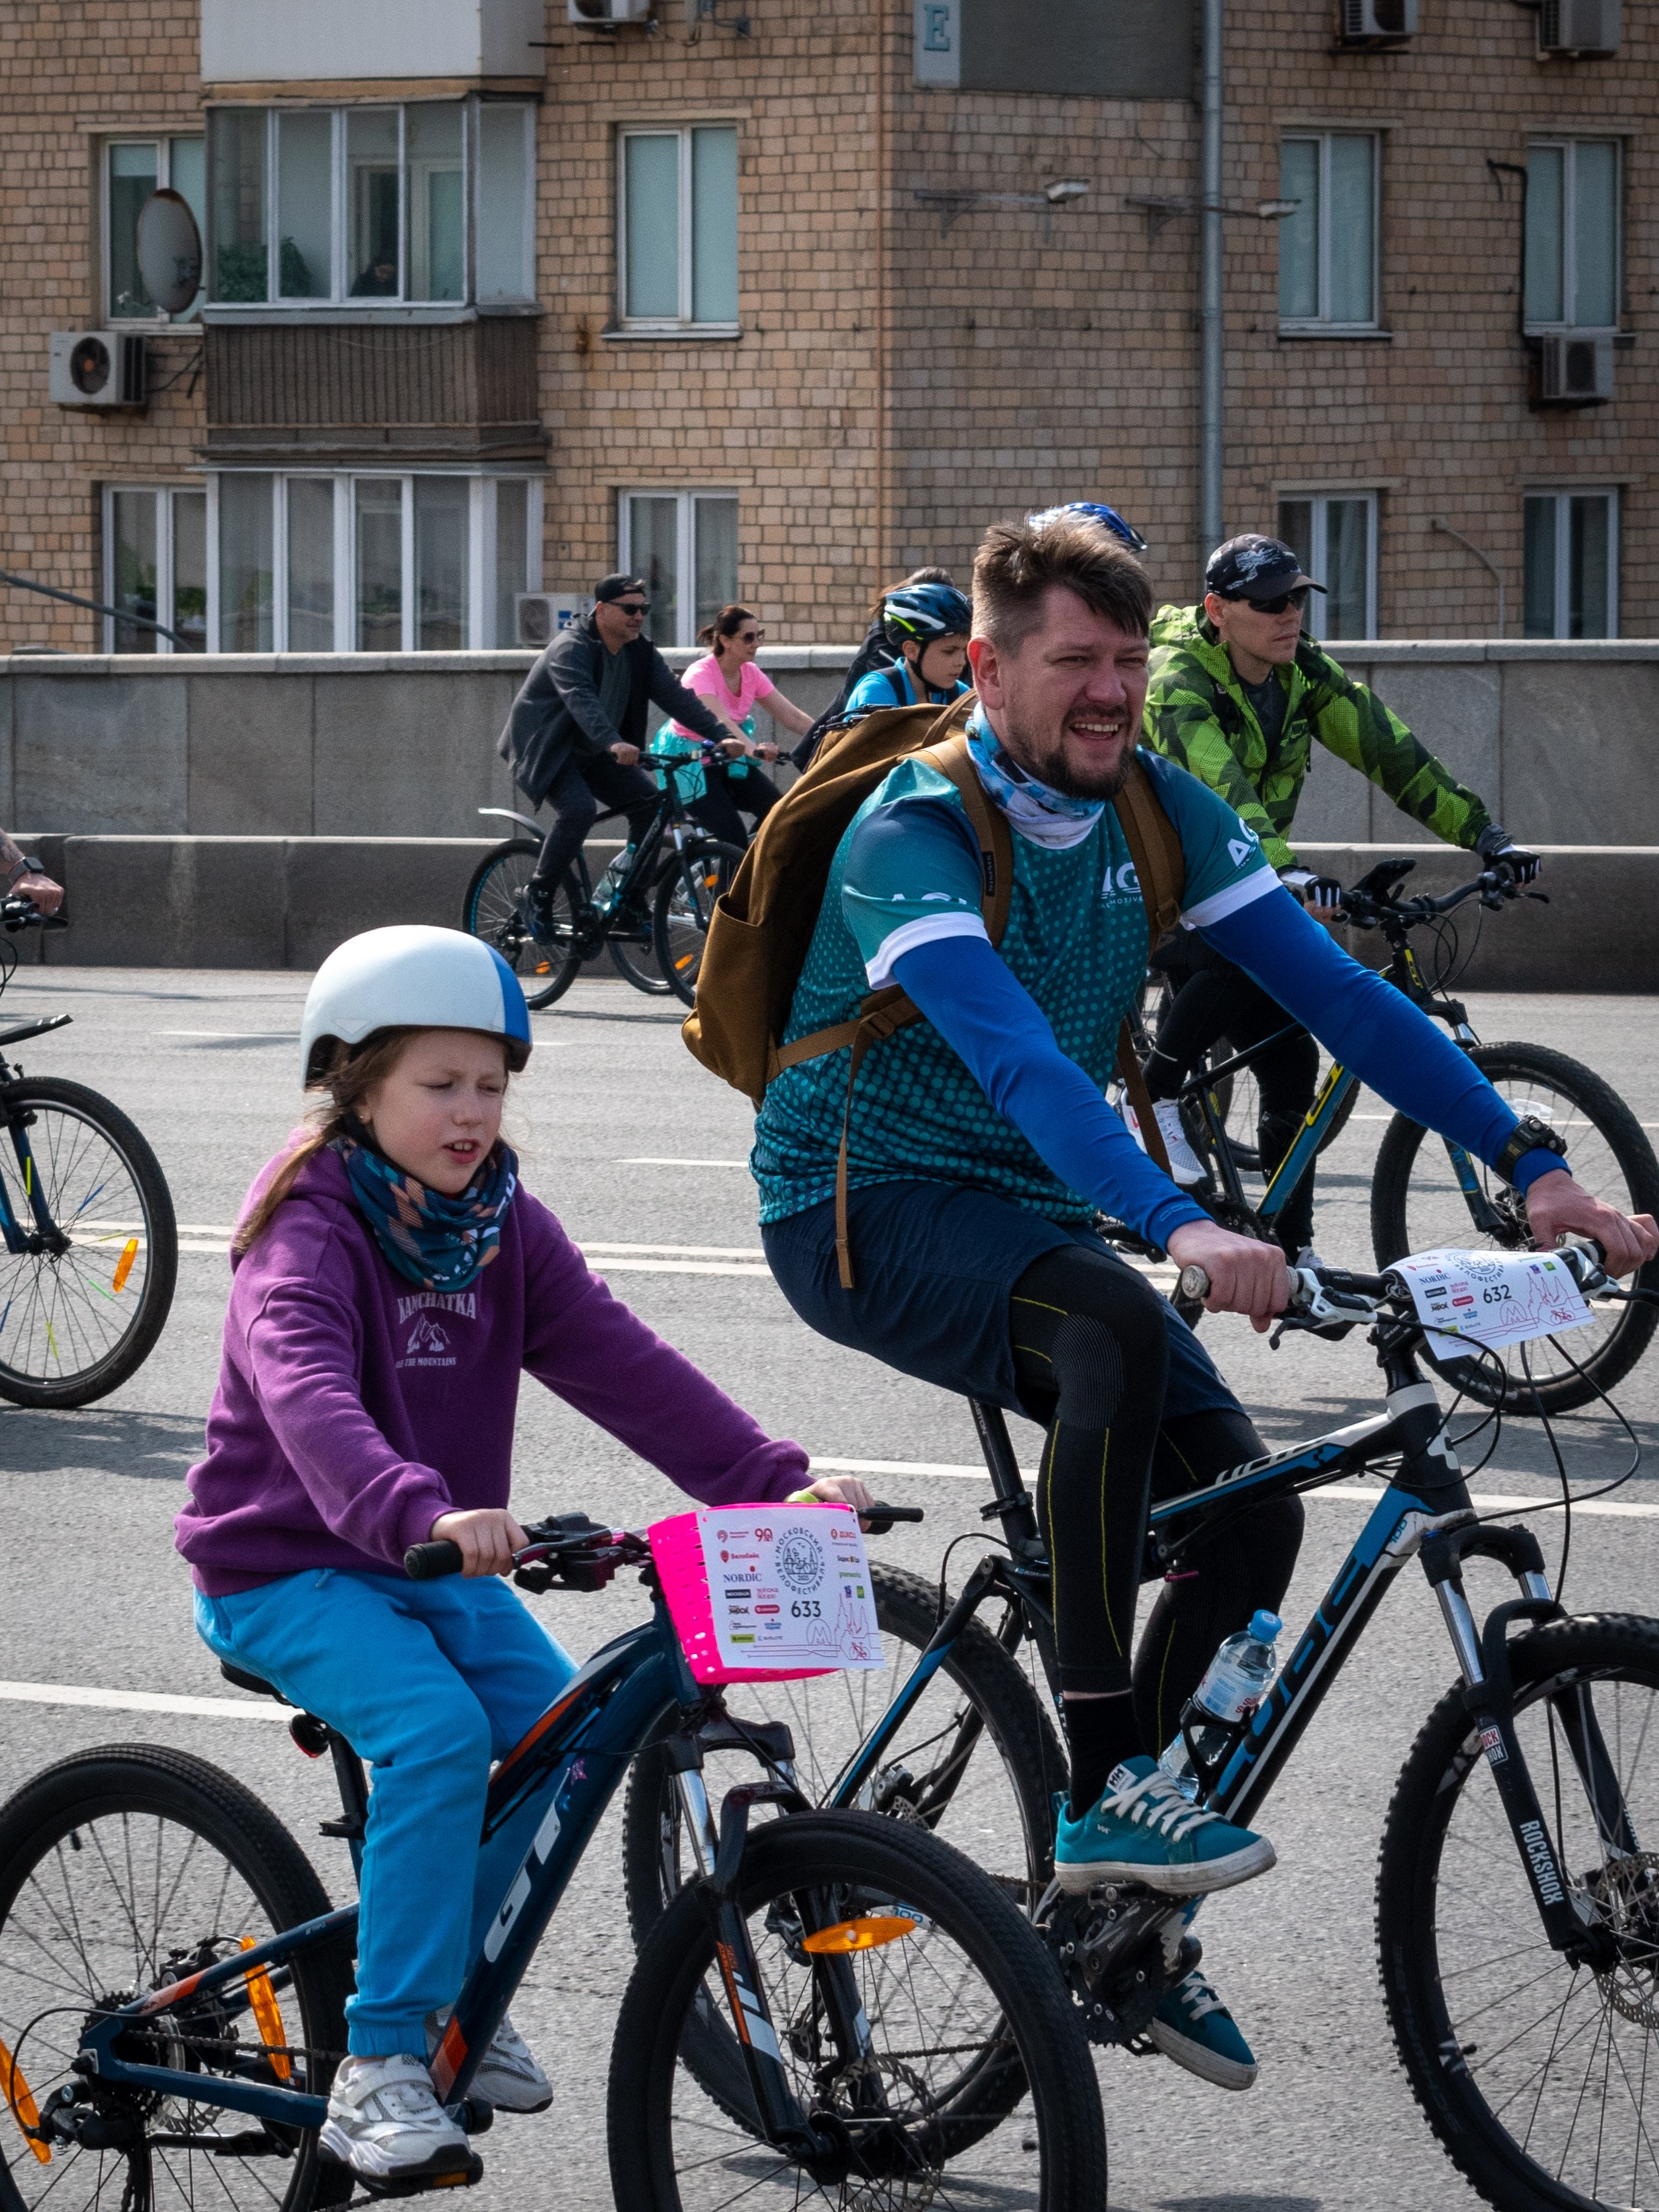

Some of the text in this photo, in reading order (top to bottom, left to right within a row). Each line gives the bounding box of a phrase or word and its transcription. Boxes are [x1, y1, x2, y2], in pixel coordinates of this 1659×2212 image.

[1419, 1273, 1451, 1284] NORDIC
[1483, 1284, 1512, 1304] 632
[417, 1357, 457, 1367] MOUNTAINS
[776, 1527, 824, 1554] МОСКОВСКИЙ
[723, 1573, 763, 1583] NORDIC
[775, 1561, 825, 1595] ВЕЛОФЕСТИВАЛЬ
[791, 1600, 821, 1618] 633
[1519, 1819, 1564, 1906] ROCKSHOX
[483, 1797, 562, 1963] GT
